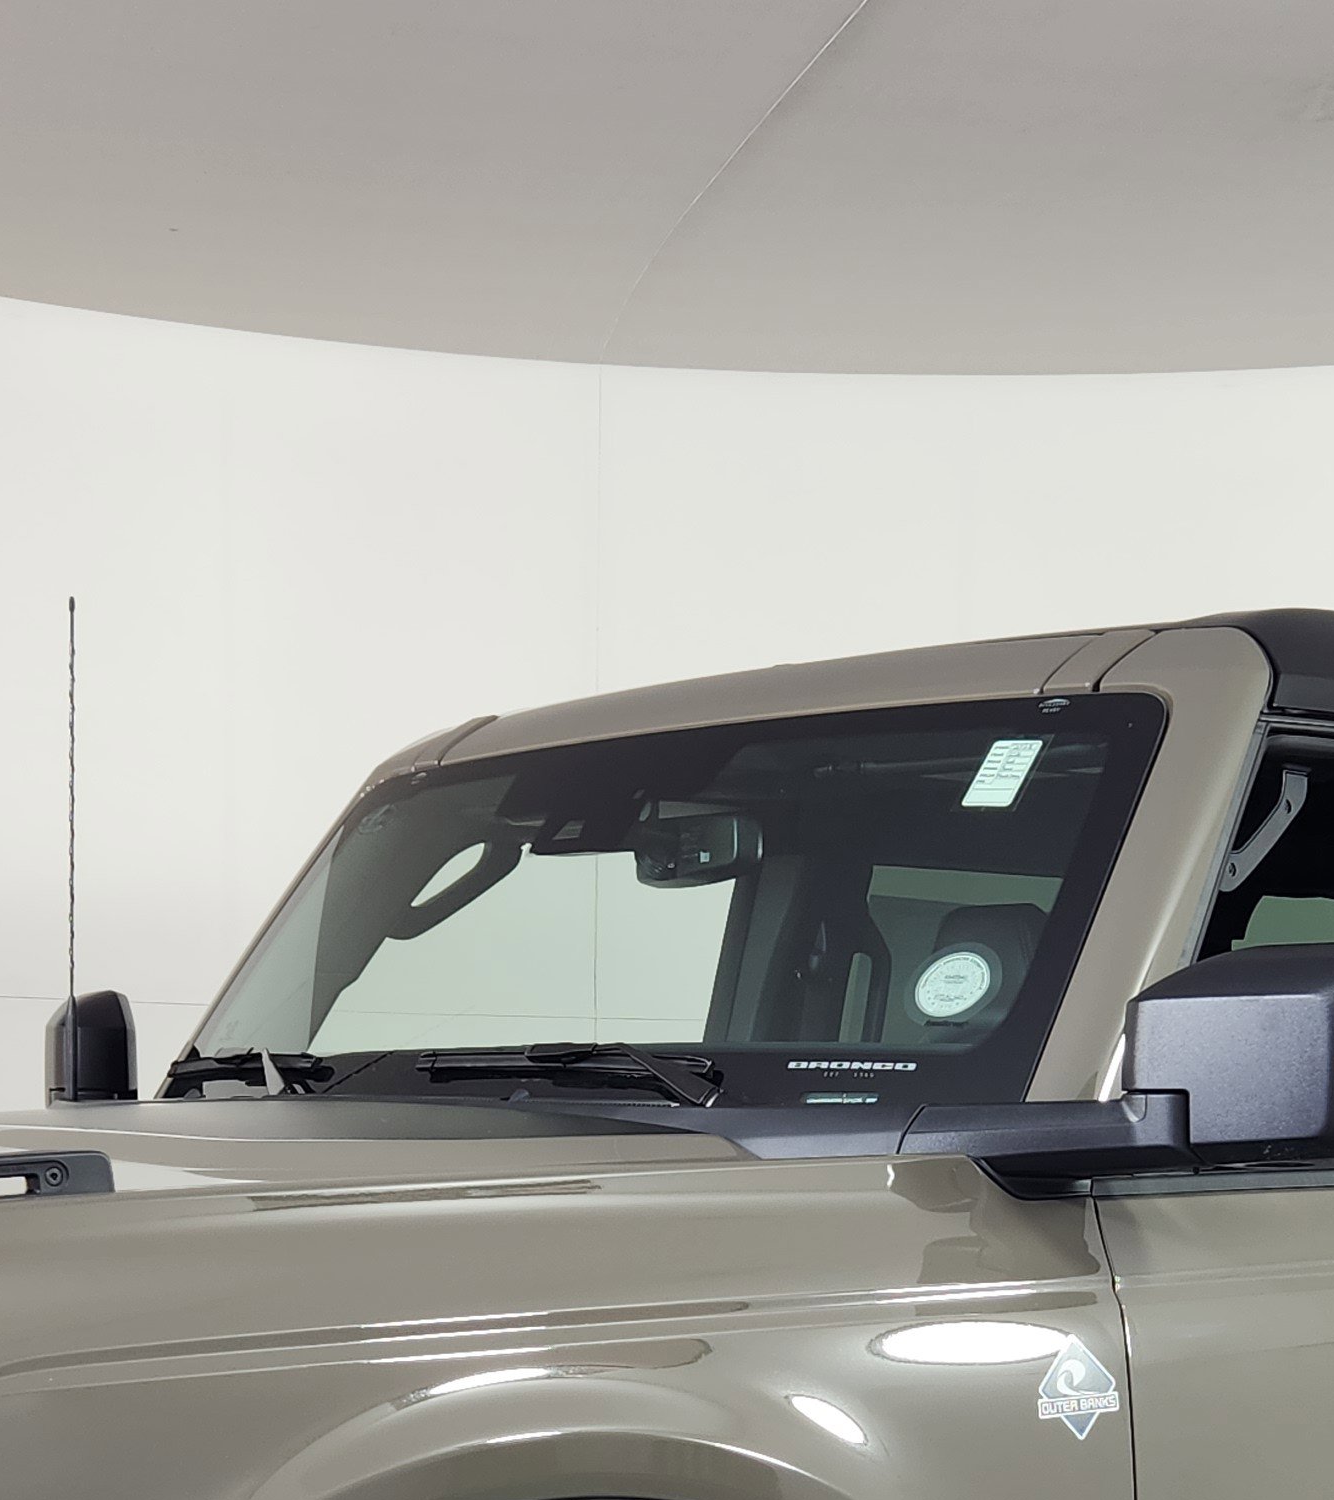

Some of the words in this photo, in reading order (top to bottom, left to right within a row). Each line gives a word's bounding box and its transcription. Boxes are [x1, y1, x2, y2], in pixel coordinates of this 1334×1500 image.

[787, 1061, 917, 1071] BRONCO
[1041, 1401, 1079, 1414] OUTER
[1080, 1396, 1117, 1410] BANKS
